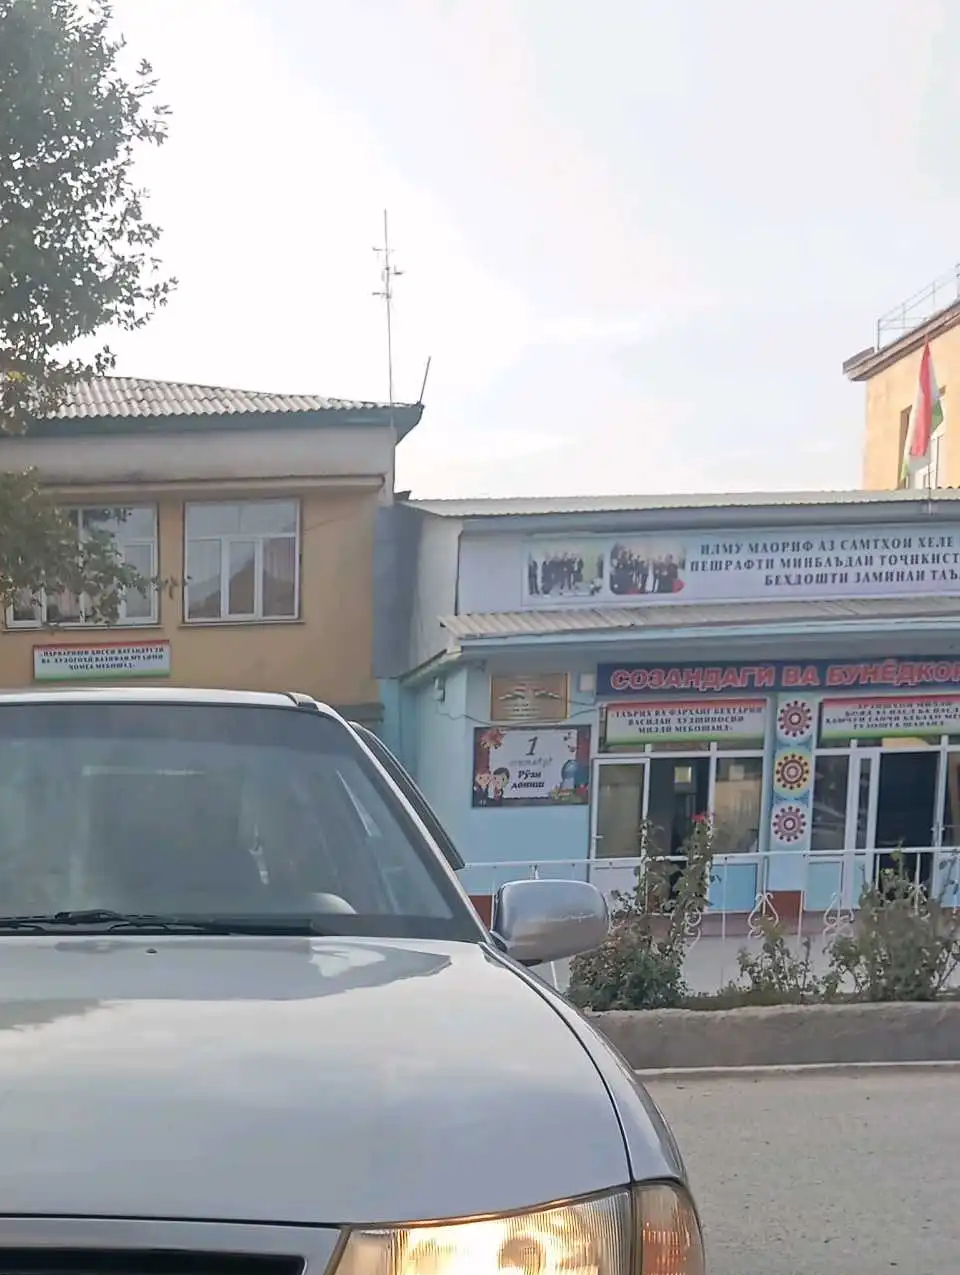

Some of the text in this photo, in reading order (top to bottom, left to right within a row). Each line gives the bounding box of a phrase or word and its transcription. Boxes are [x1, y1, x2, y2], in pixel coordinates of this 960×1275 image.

[700, 543, 743, 556] ИЛМУ
[747, 540, 814, 554] МАОРИФ
[818, 539, 835, 552] АЗ
[918, 536, 954, 549] ХЕЛЕ
[690, 559, 775, 572] ПЕШРАФТИ
[930, 568, 960, 580] ТАЪ
[611, 666, 776, 692] СОЗАНДАГИ
[781, 664, 820, 687] ВА
[526, 736, 538, 756] 1
